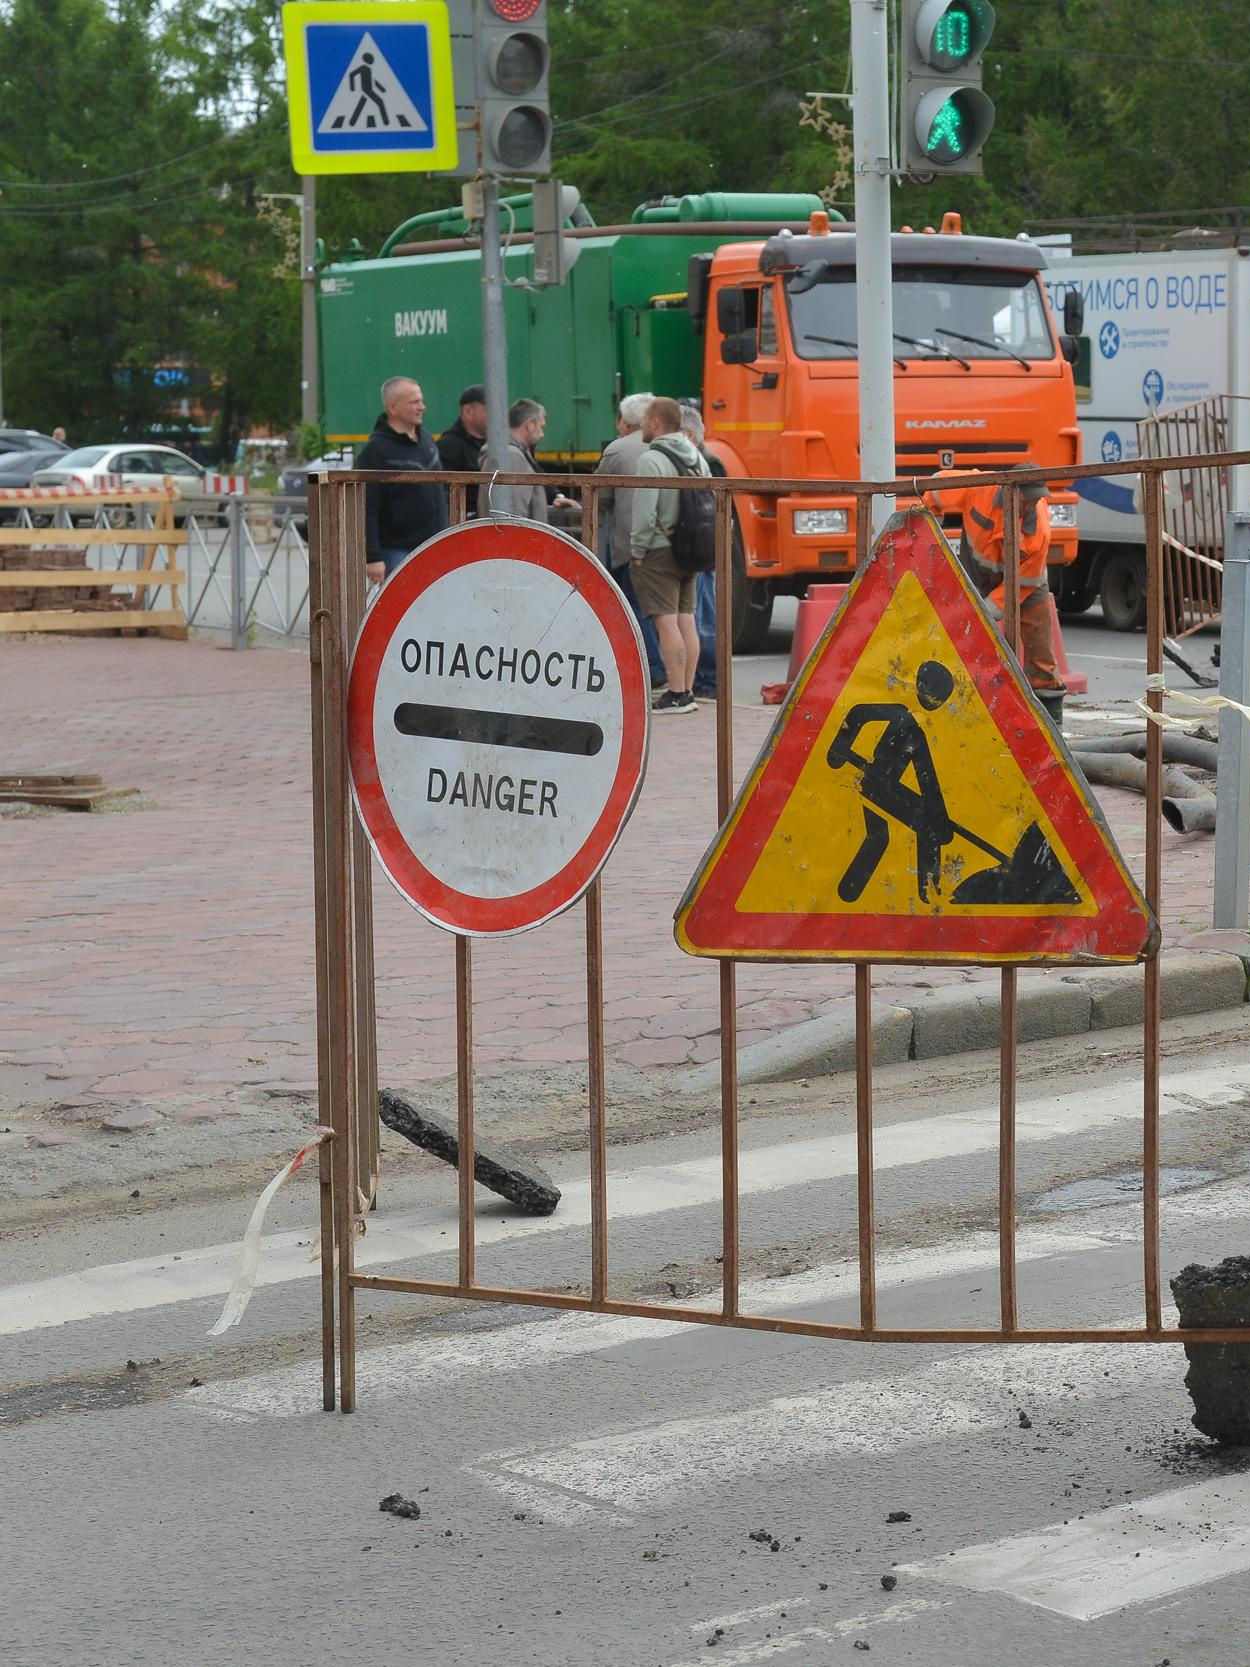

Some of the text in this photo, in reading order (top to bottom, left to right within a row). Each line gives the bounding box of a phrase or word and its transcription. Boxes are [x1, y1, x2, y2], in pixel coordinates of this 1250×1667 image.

[936, 11, 970, 57] 10
[1145, 276, 1160, 310] О
[1166, 274, 1227, 315] ВОДЕ
[394, 308, 448, 337] ВАКУУМ
[905, 419, 987, 430] KAMAZ
[401, 638, 605, 692] ОПАСНОСТЬ
[427, 767, 558, 818] DANGER
